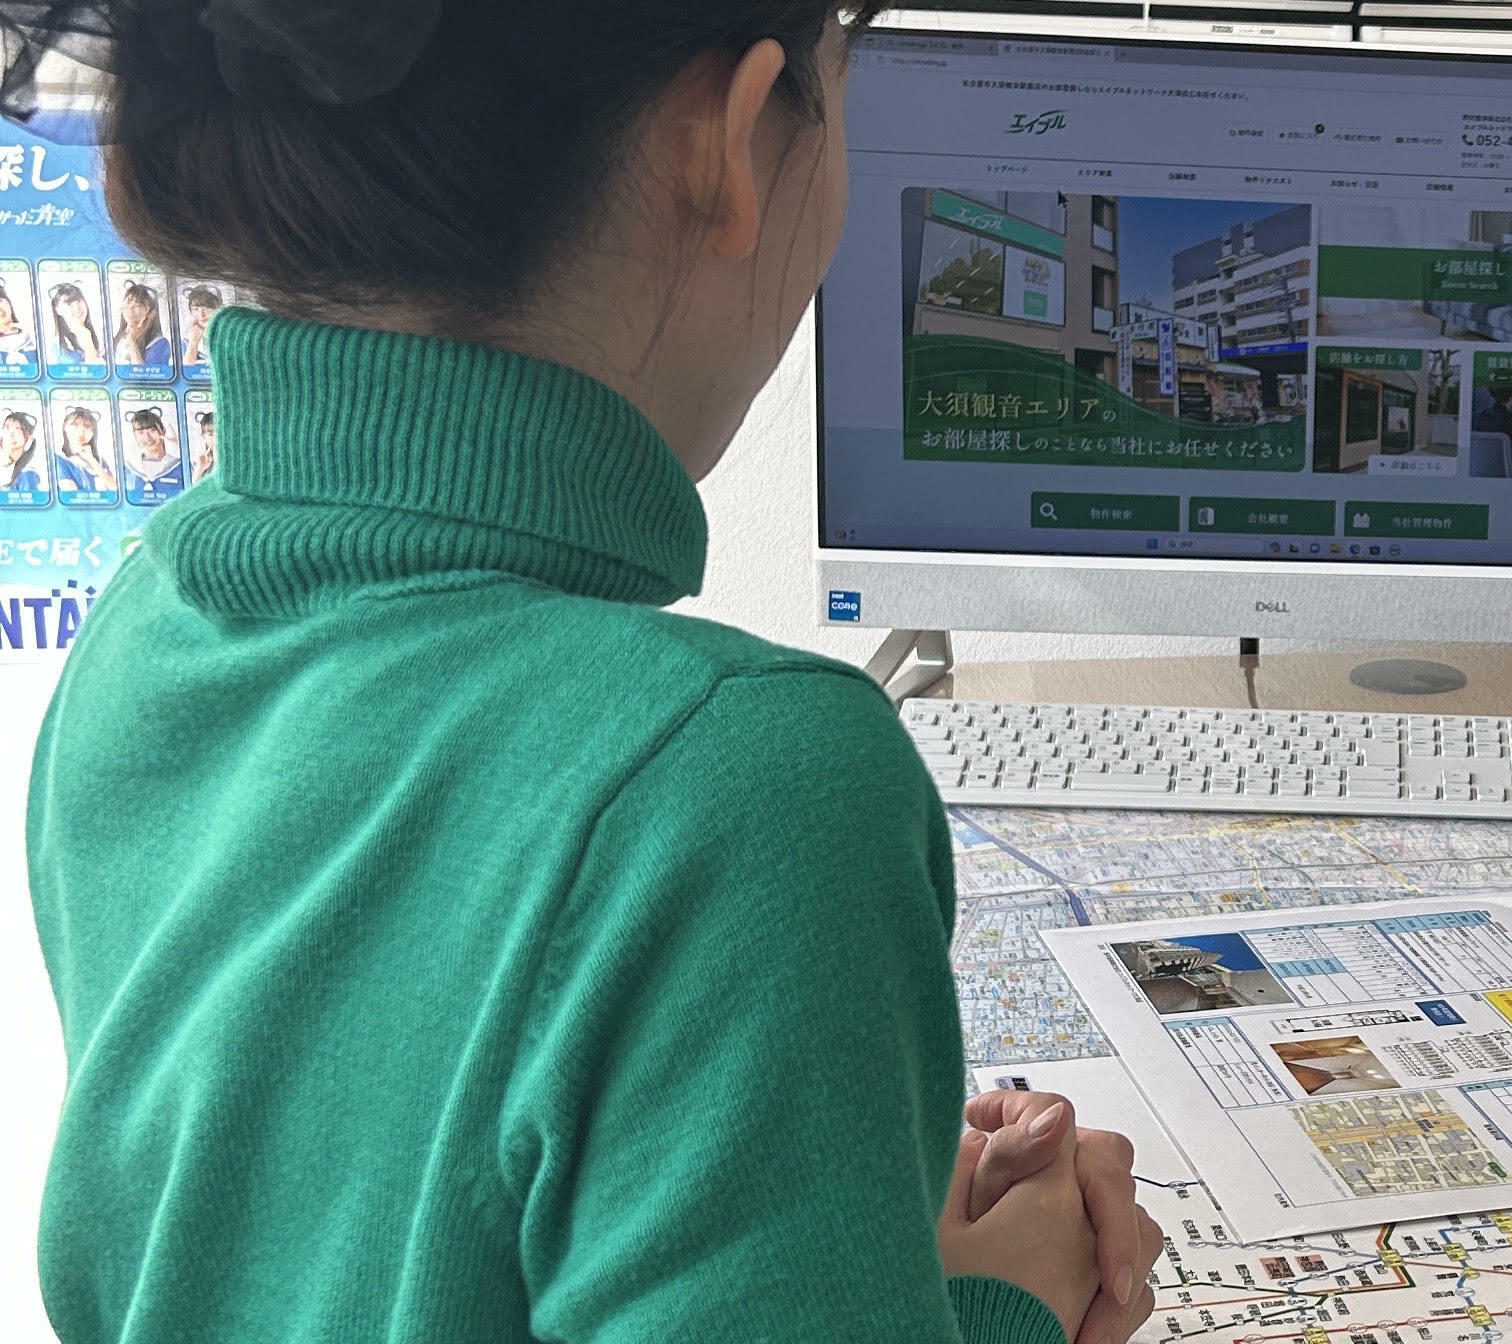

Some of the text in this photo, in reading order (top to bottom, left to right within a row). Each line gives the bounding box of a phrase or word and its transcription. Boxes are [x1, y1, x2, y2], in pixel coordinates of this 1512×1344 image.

[1005, 109, 1067, 135] エイブル
[1432, 259, 1507, 277] お部屋探し
[918, 389, 1117, 425] 大須観音エリアの
[921, 427, 1294, 461] お部屋探しのことなら当社にお任せください
[1090, 507, 1134, 522] 物件検索
[1246, 511, 1290, 527] 会社概要
[1254, 600, 1291, 614] DELL
